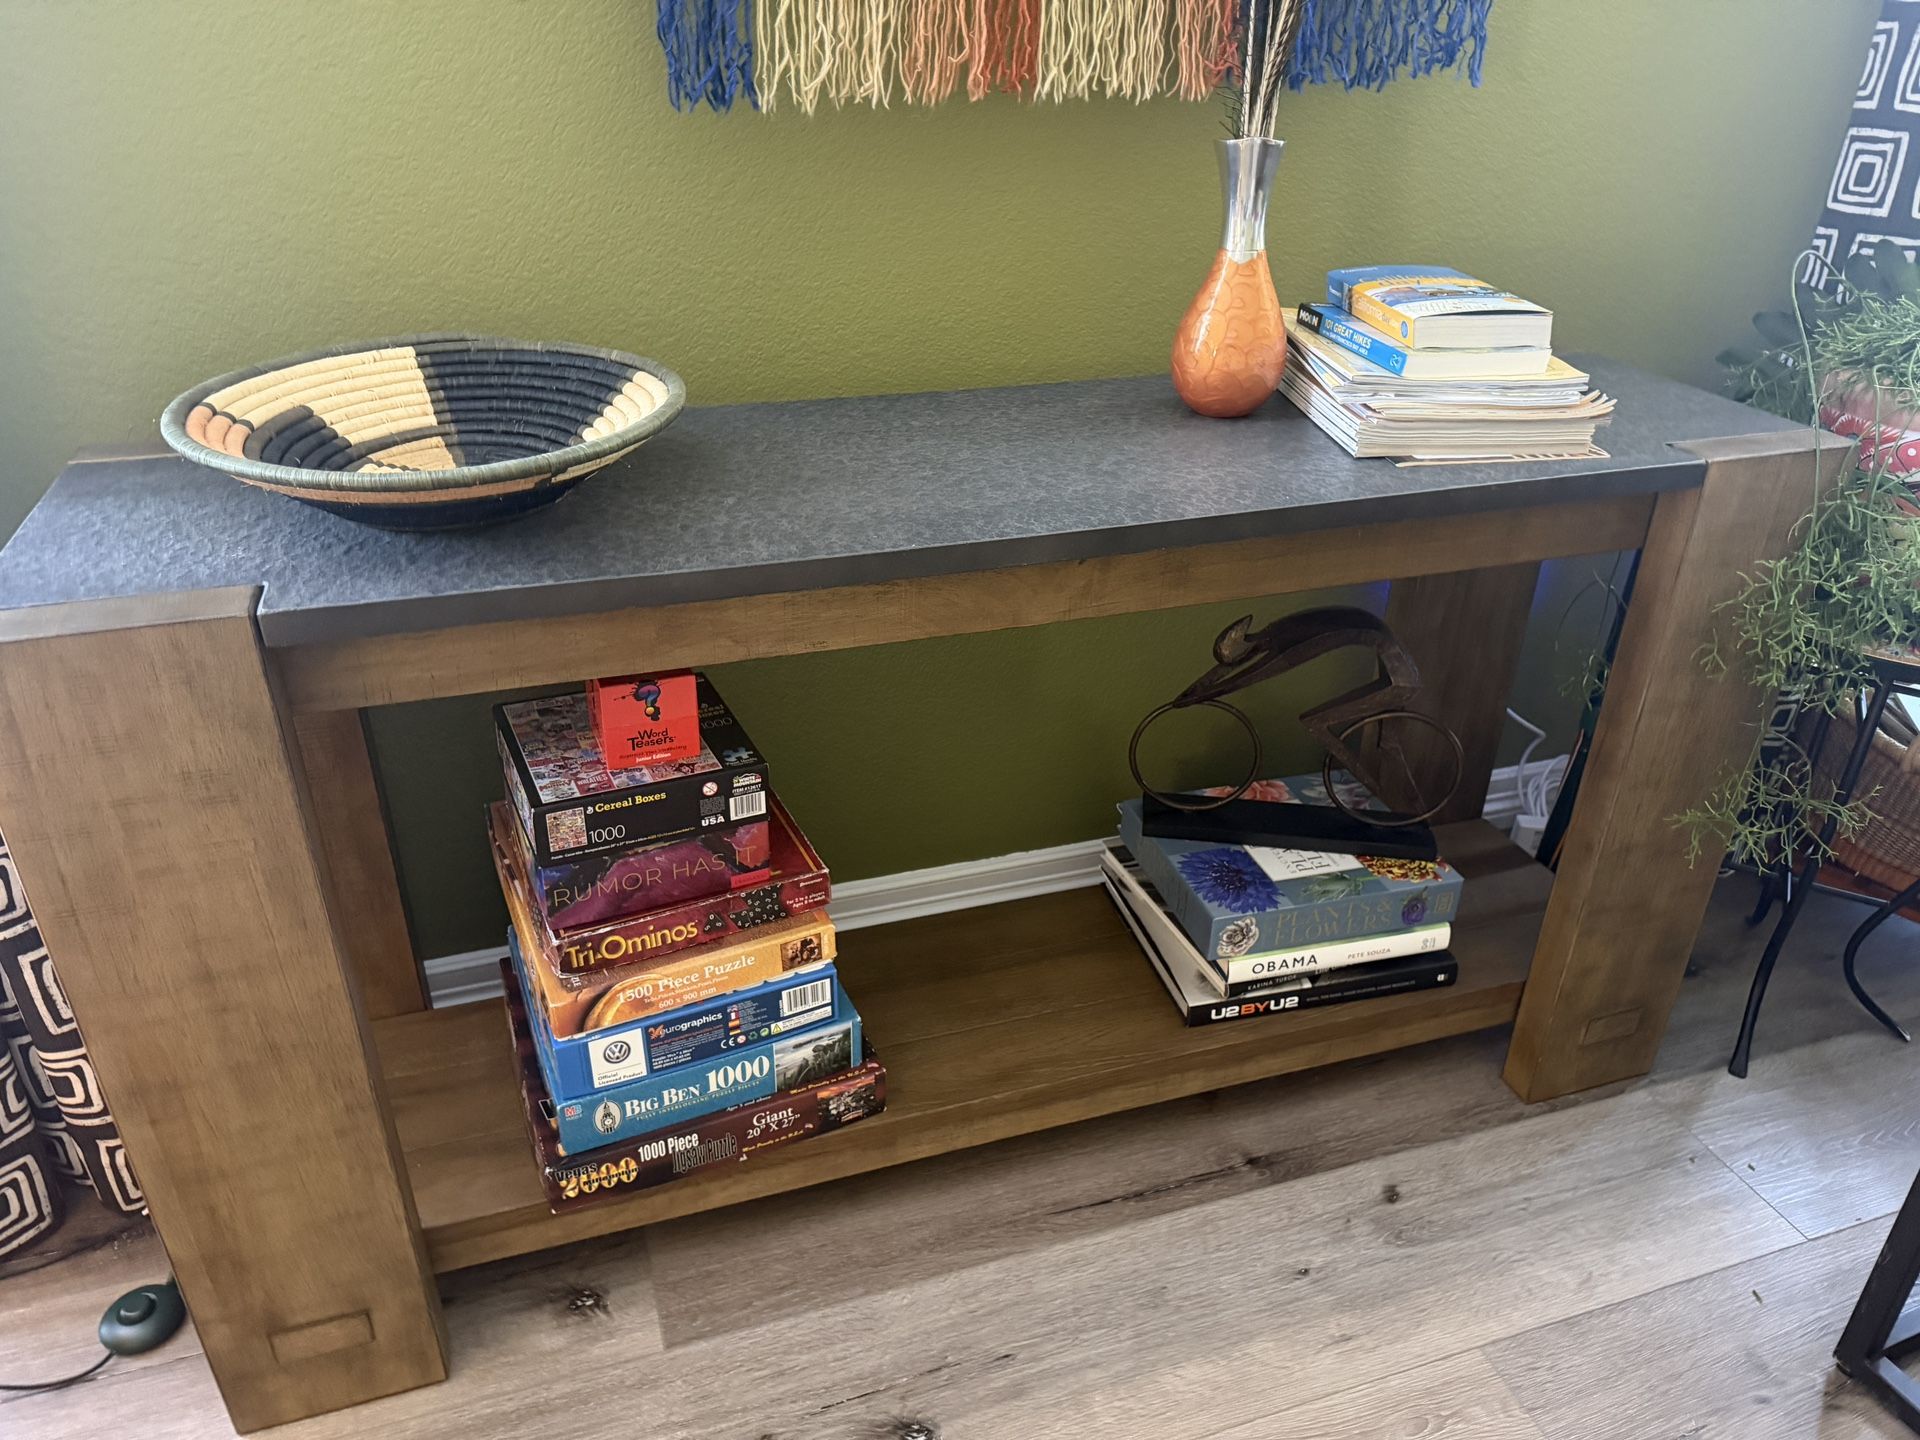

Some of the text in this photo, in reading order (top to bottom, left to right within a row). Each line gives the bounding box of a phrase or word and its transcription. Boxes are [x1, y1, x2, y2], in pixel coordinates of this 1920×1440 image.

[1299, 309, 1319, 327] MOON
[1324, 318, 1334, 330] 101
[1333, 321, 1353, 338] GREAT
[1353, 330, 1373, 349] HIKES
[627, 736, 675, 751] Teasers
[638, 727, 669, 740] Word
[636, 755, 652, 763] Junior
[653, 752, 672, 760] Edition
[595, 791, 667, 813] Cereal Boxes
[701, 815, 725, 827] USA
[589, 824, 626, 844] 1000
[553, 869, 662, 907] RUMOR
[672, 852, 726, 881] HAS
[735, 845, 757, 865] IT
[1277, 901, 1392, 928] PLANTS &
[1275, 916, 1392, 945] FLOWERS
[1252, 954, 1318, 975] OBAMA
[1348, 951, 1365, 959] PETE
[1366, 948, 1391, 956] SOUZA
[616, 984, 653, 1004] 1500
[658, 972, 700, 993] Piece
[704, 955, 756, 978] Puzzle
[1247, 980, 1273, 991] KARINA
[658, 999, 674, 1009] 600
[683, 991, 698, 1001] 900
[699, 986, 716, 997] mm
[598, 1072, 618, 1080] Official
[599, 1071, 643, 1085] Licensed Product
[706, 1055, 770, 1095] 1000
[564, 1105, 582, 1117] MB
[623, 1083, 700, 1118] BIG BEN
[752, 1107, 794, 1127] Giant
[769, 1121, 779, 1133] X
[638, 1133, 699, 1162] 1000 Piece
[672, 1132, 737, 1174] Jigsaw Puzzle
[554, 1163, 598, 1183] Vegas
[560, 1157, 639, 1200] 2000
